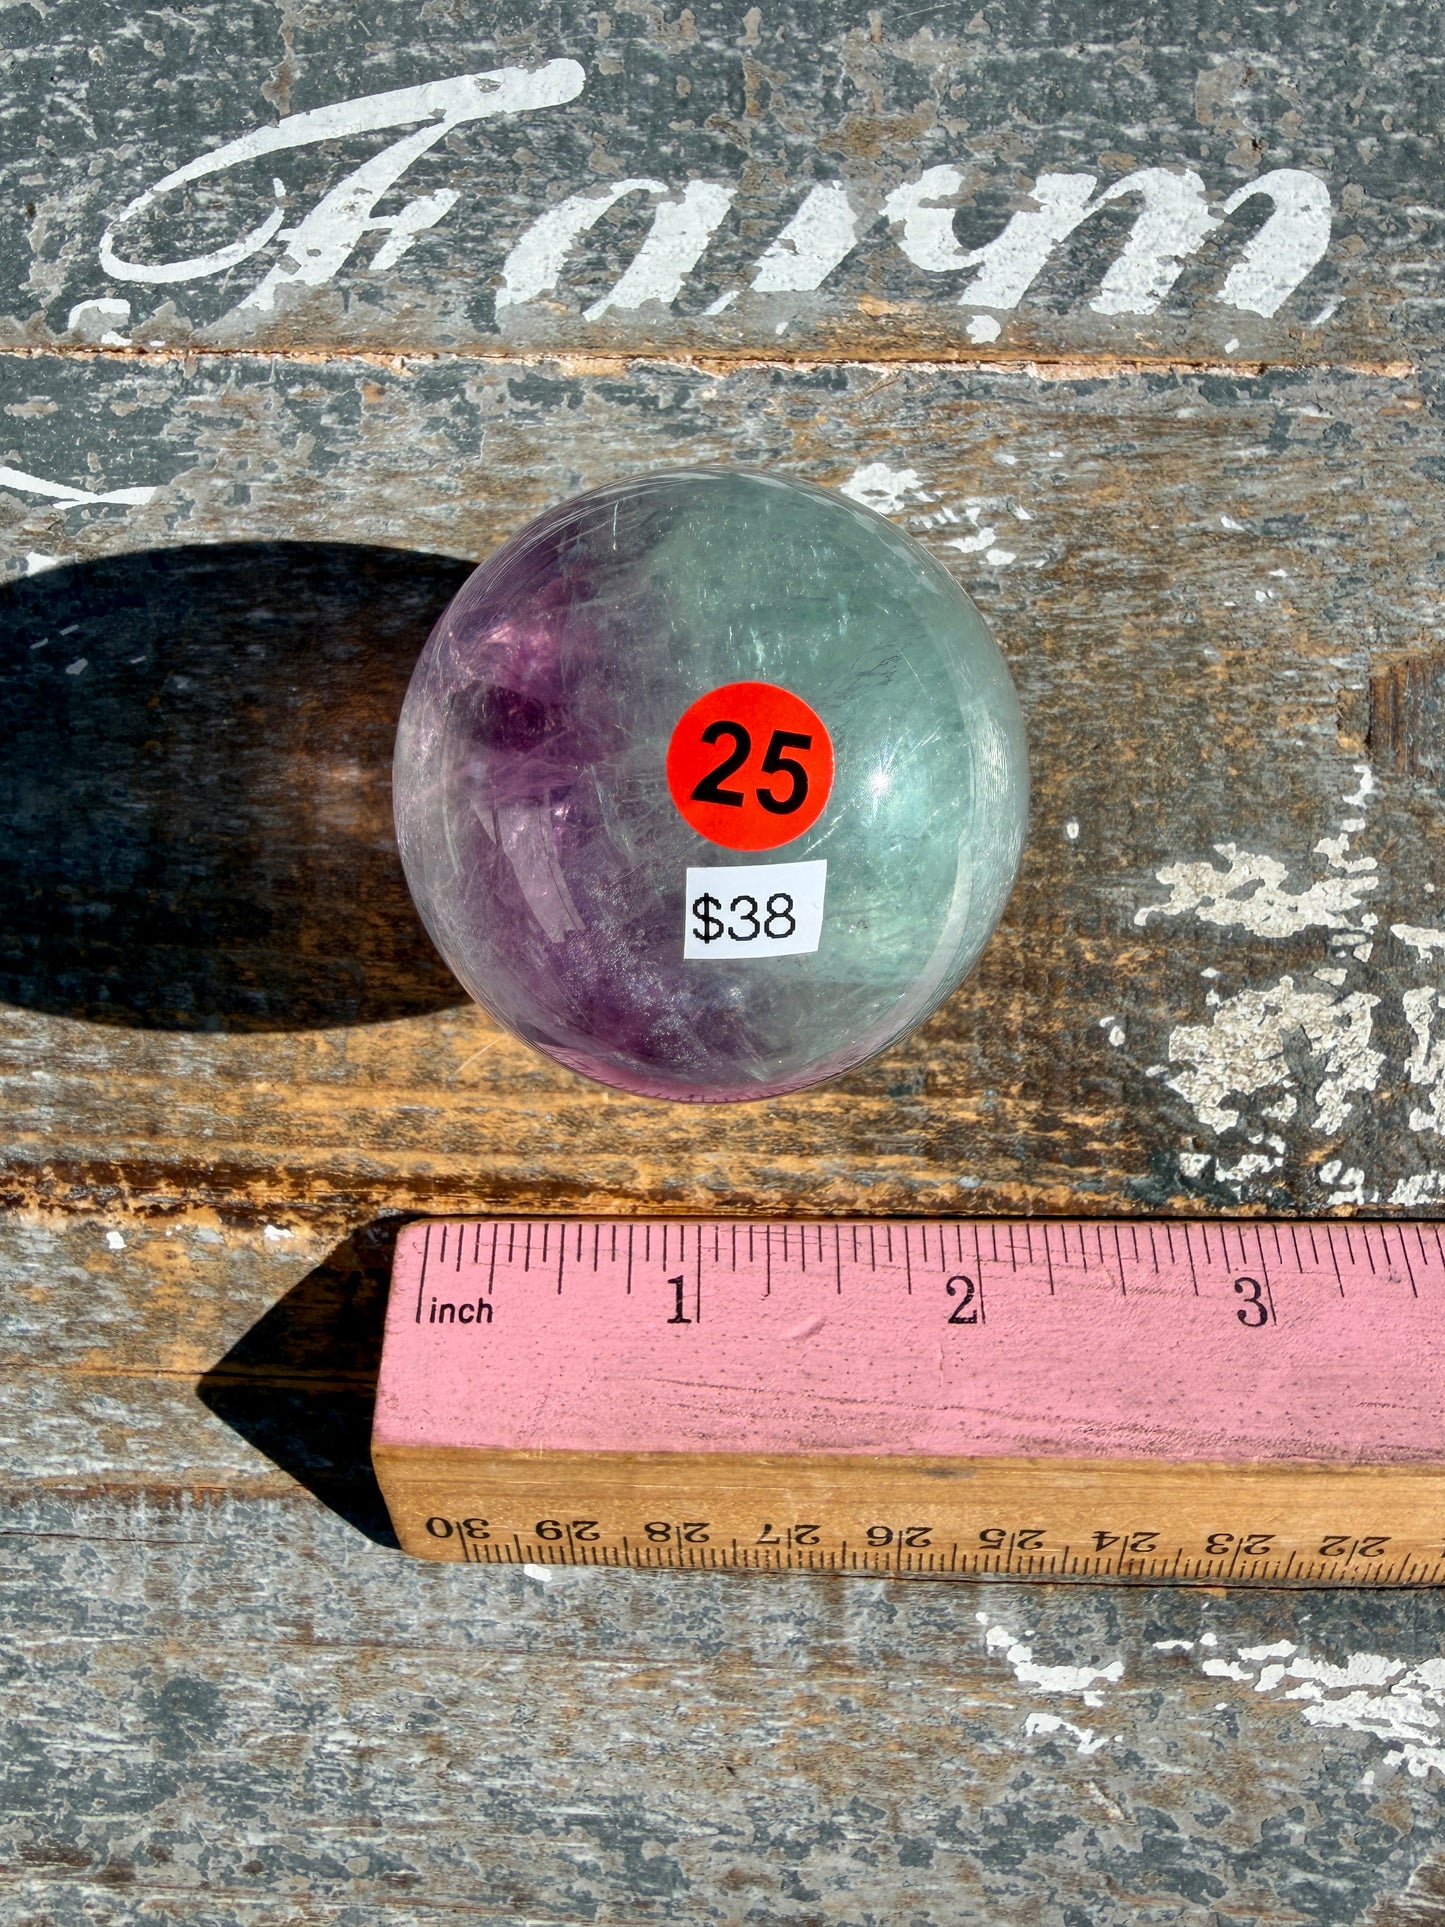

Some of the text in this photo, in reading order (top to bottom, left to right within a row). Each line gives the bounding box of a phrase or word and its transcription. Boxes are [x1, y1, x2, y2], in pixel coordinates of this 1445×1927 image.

[690, 720, 812, 815] 25
[692, 892, 796, 944] $38
[429, 1296, 493, 1325] inch
[666, 1275, 1269, 1328] 1 2 3
[425, 1516, 1392, 1558] 22 23 24 25 26 27 28 29 30
